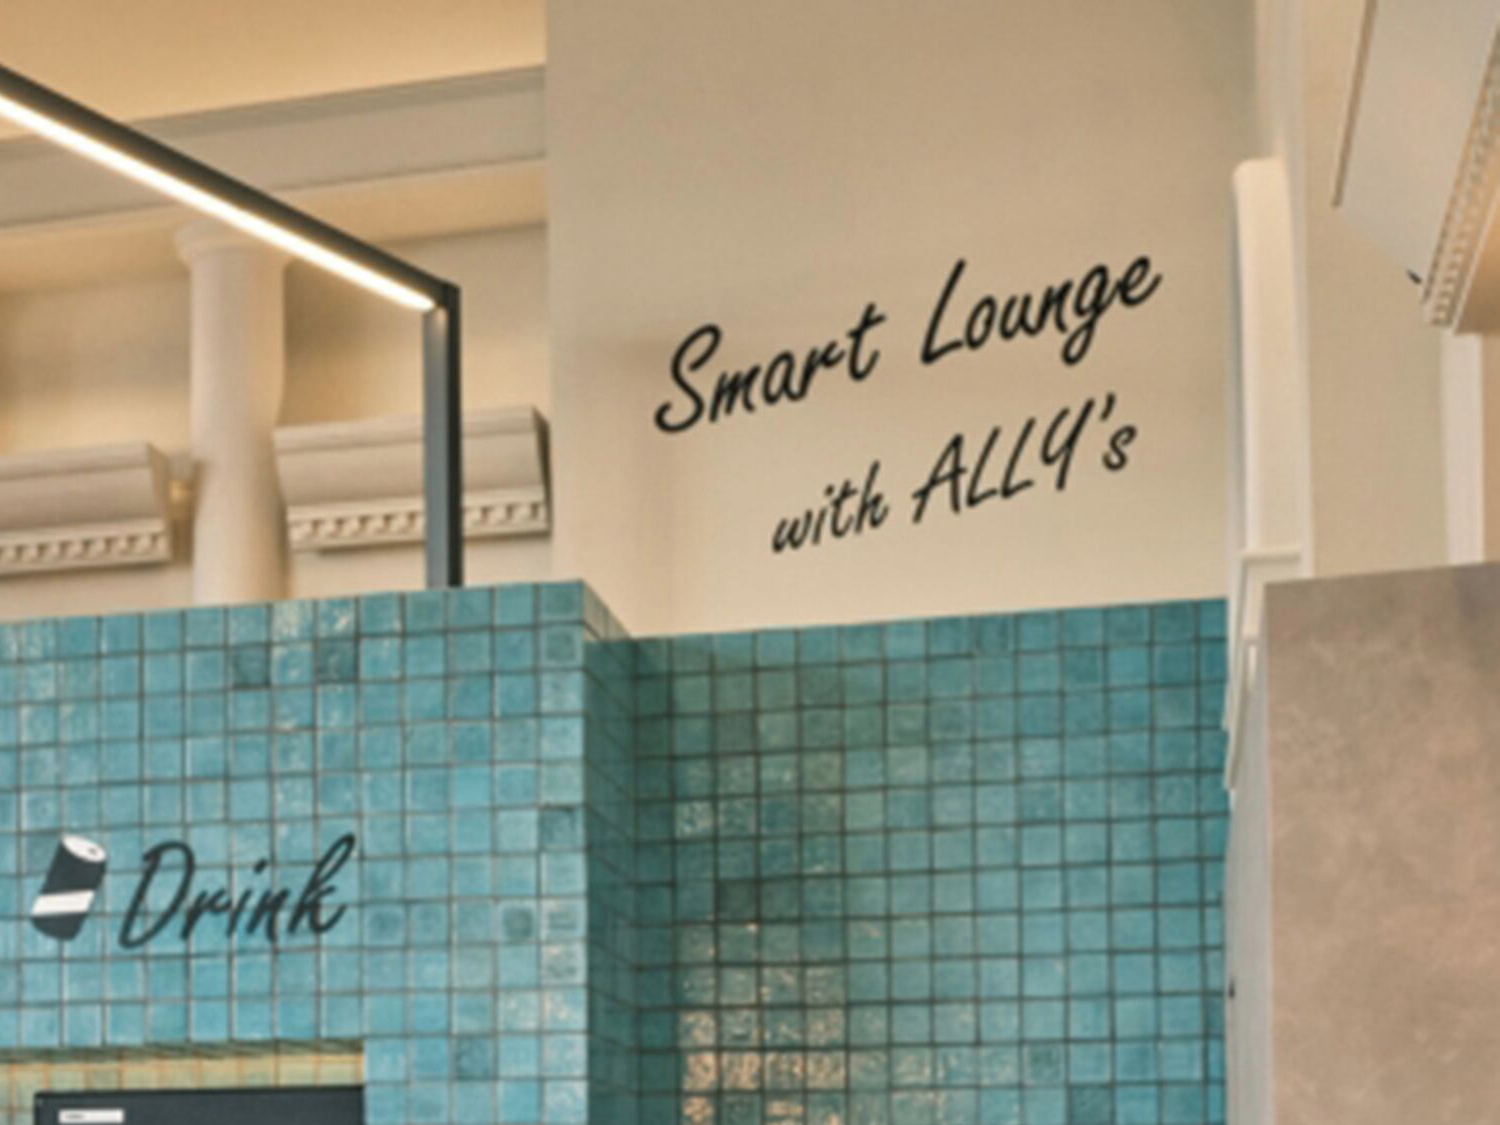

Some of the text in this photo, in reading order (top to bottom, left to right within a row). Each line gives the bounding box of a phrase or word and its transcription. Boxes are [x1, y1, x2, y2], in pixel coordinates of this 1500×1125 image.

[653, 255, 1163, 435] Smart Lounge
[771, 391, 1138, 554] with ALLY's
[117, 832, 357, 950] Drink
